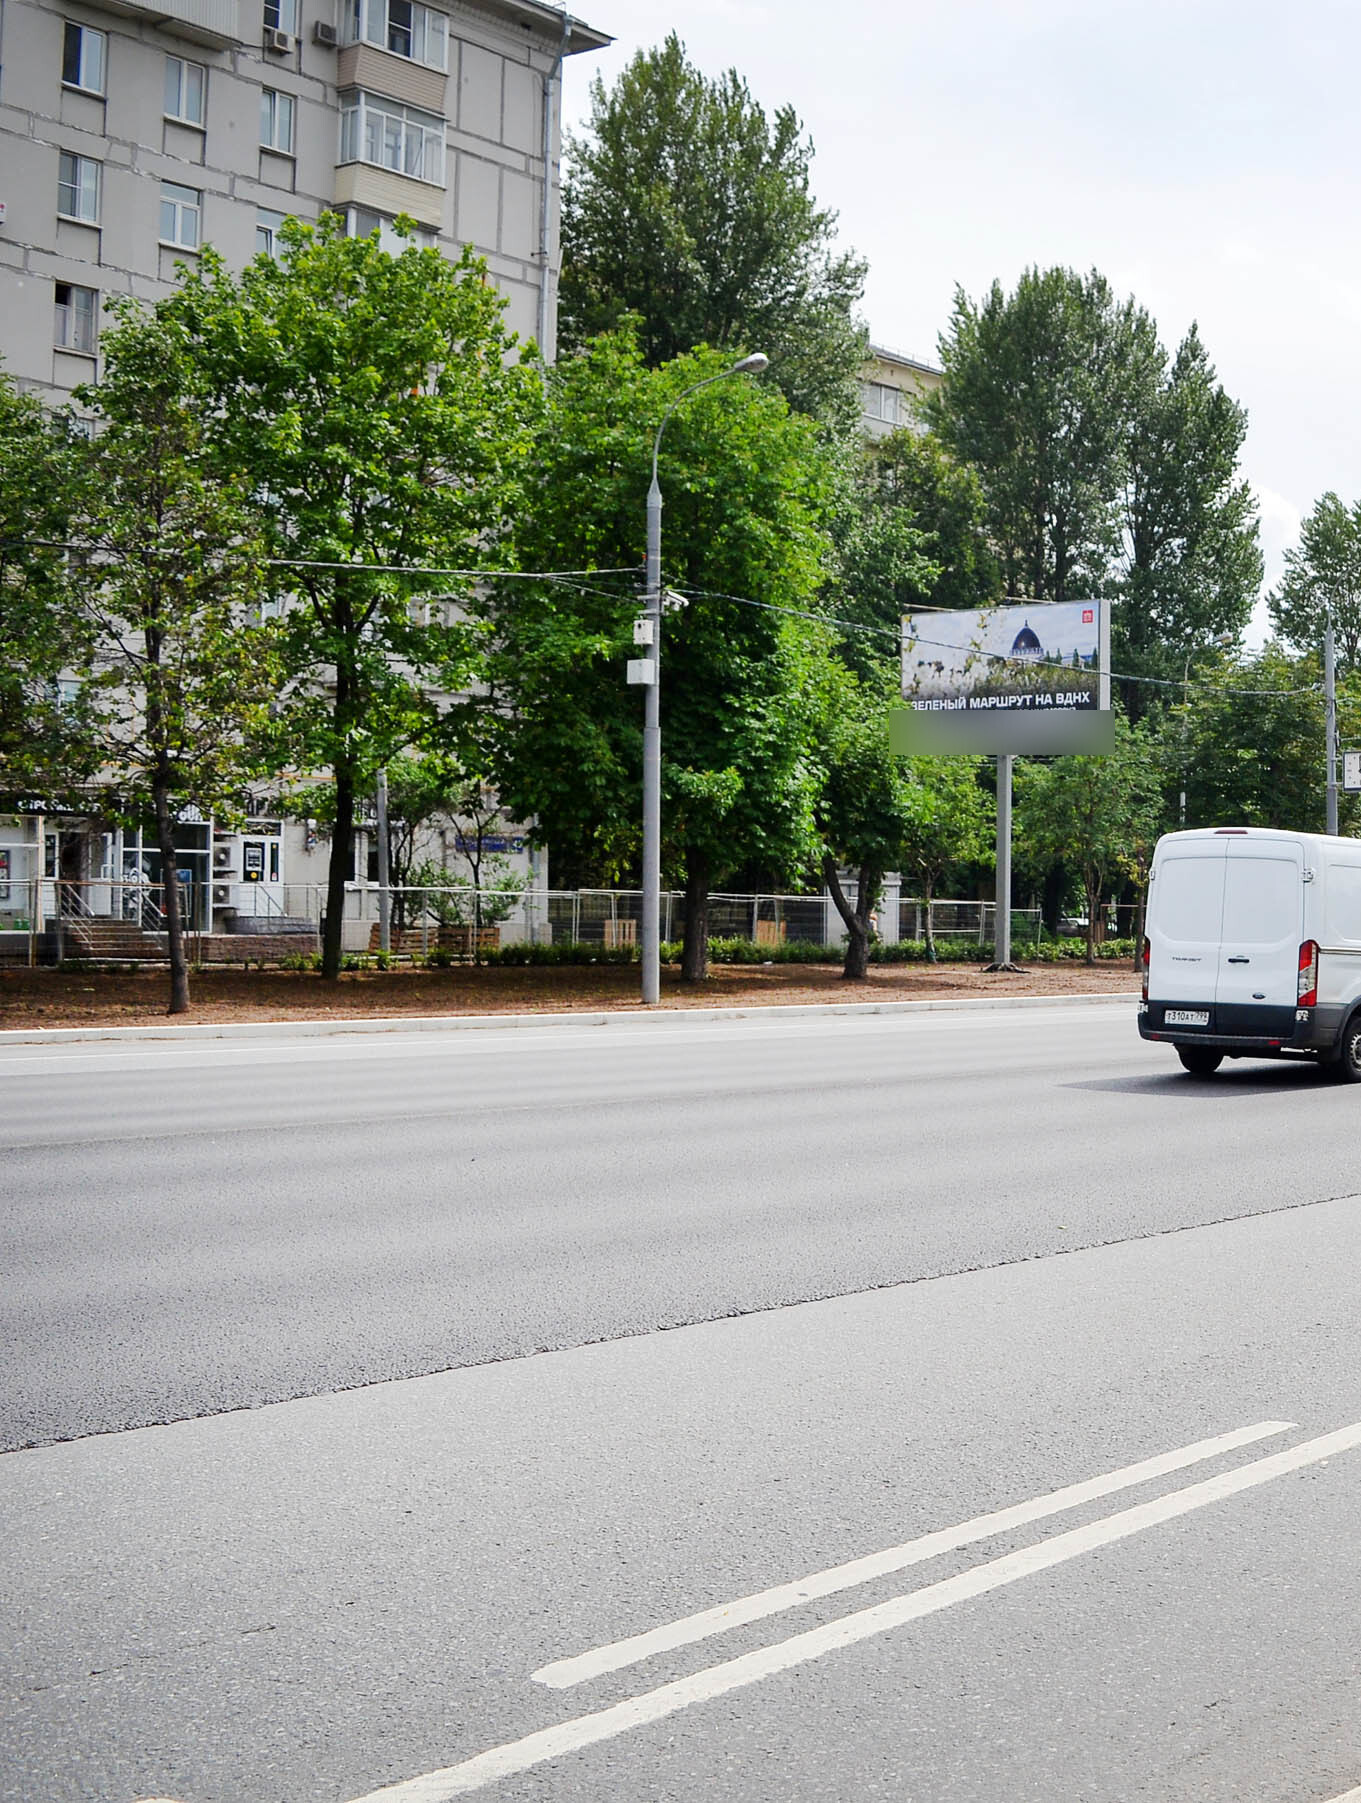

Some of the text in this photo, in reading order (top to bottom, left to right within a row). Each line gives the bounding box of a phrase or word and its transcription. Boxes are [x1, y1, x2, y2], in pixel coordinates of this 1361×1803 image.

[970, 695, 1032, 708] МАРШРУТ
[1036, 694, 1051, 705] НА
[1056, 692, 1090, 704] ВДНХ
